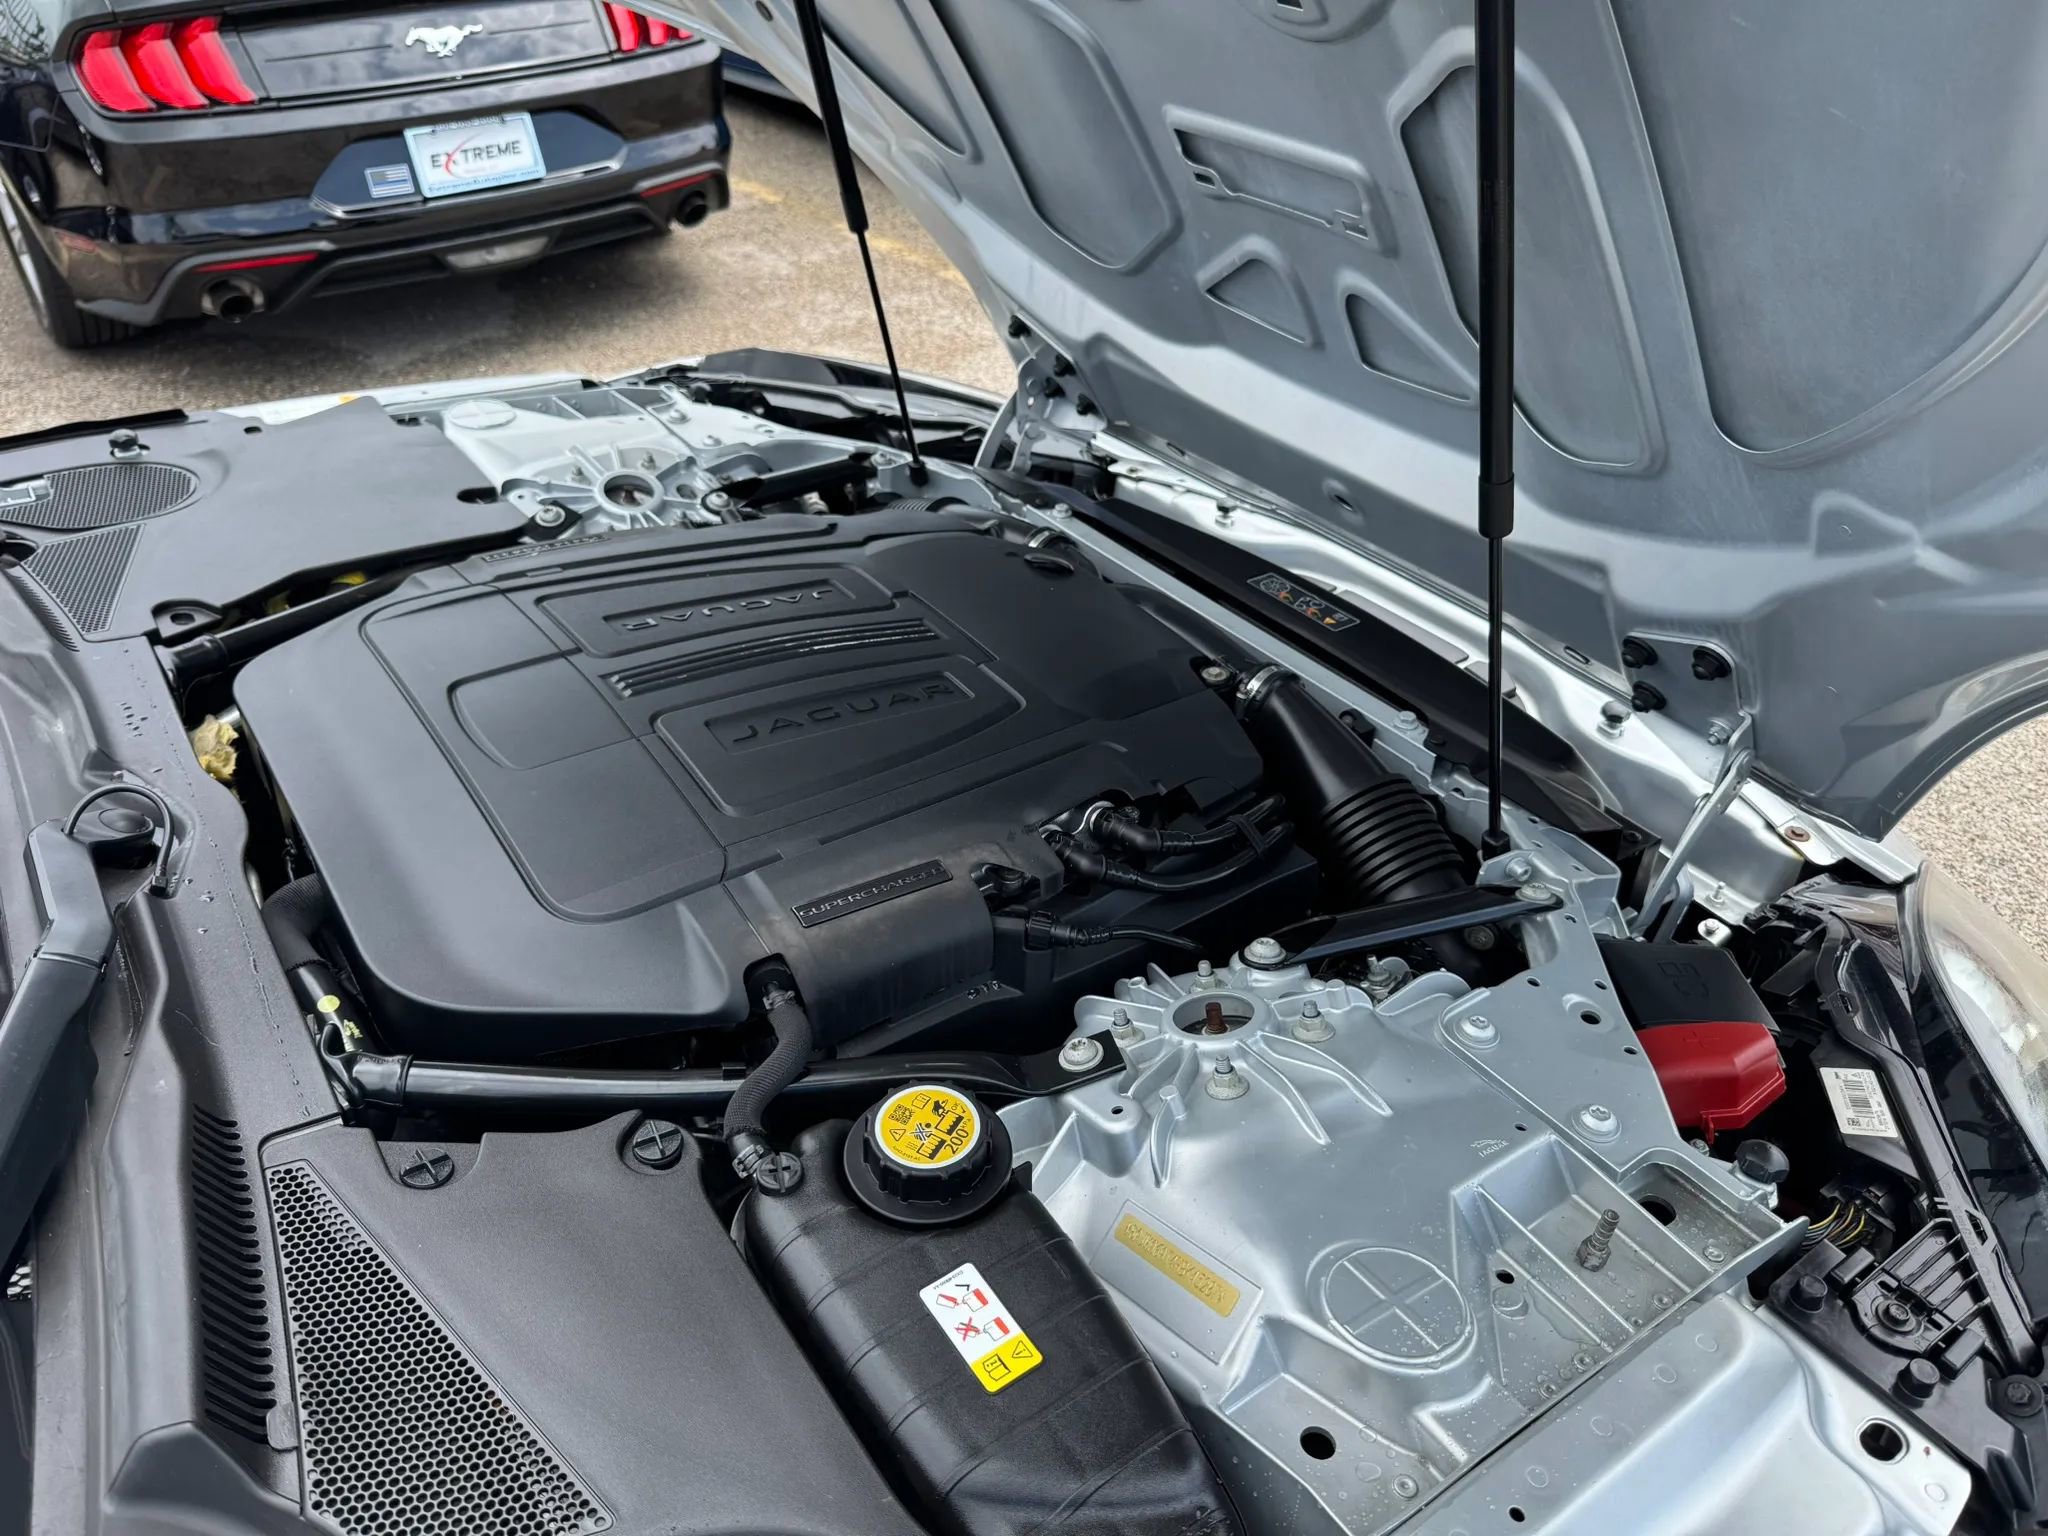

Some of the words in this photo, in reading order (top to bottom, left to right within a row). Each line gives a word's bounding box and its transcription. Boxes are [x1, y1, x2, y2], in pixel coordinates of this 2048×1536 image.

[431, 140, 522, 169] EXTREME
[626, 588, 834, 632] JAGUAR
[732, 684, 955, 744] JAGUAR
[800, 865, 946, 918] SUPERCHARGED
[943, 1127, 969, 1155] 200
